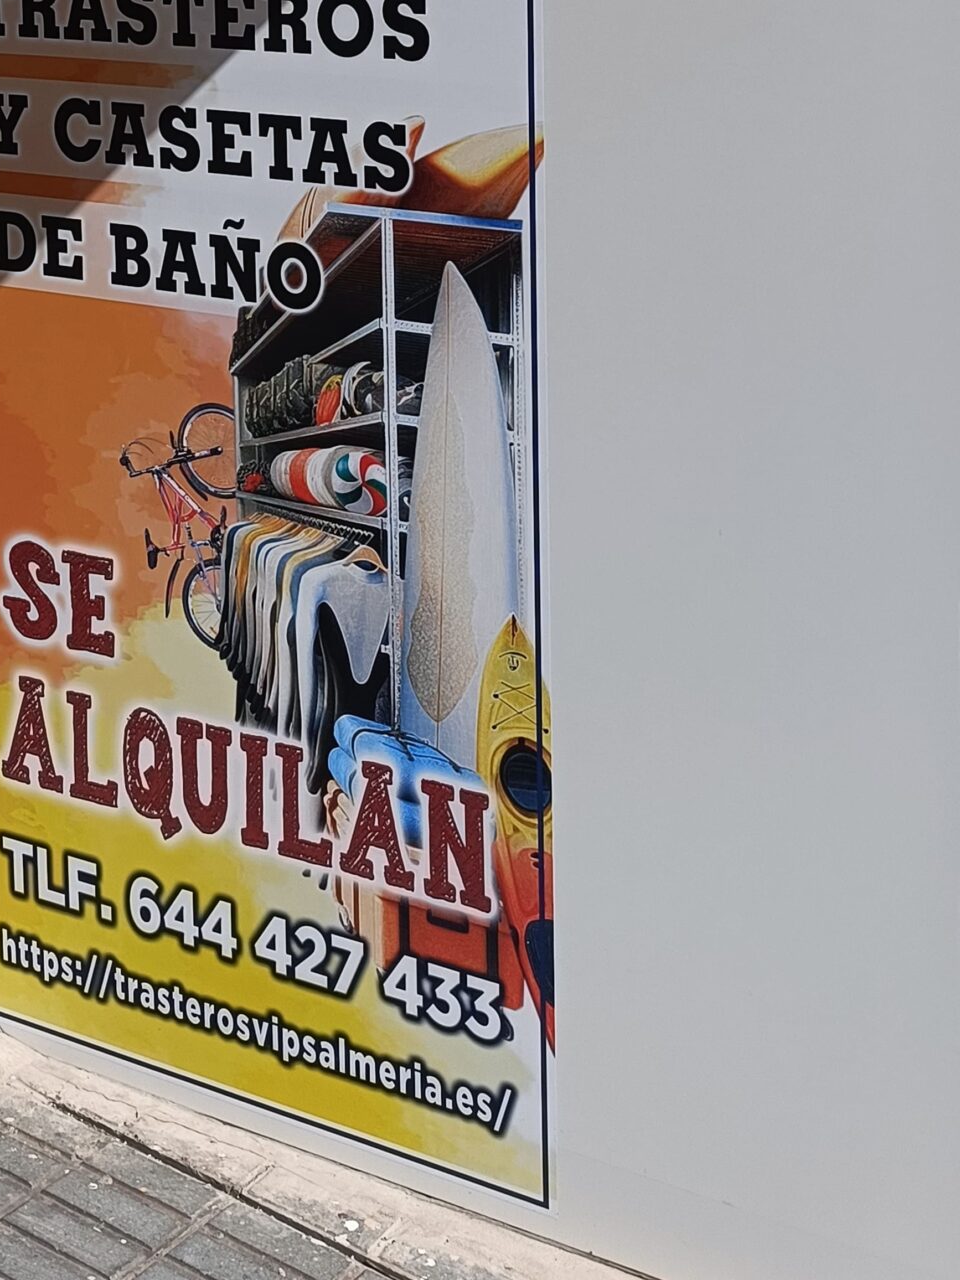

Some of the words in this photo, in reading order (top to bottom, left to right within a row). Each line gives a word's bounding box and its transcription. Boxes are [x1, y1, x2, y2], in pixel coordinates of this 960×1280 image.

[54, 97, 414, 194] CASETAS
[109, 218, 325, 313] BAÑO
[2, 539, 116, 659] SE
[1, 674, 493, 915] ALQUILAN
[2, 836, 114, 922] TLF.
[128, 875, 236, 958] 644
[254, 916, 365, 995] 427
[383, 955, 502, 1040] 433
[1, 928, 513, 1132] https://trasterosvipsalmeria.es/
